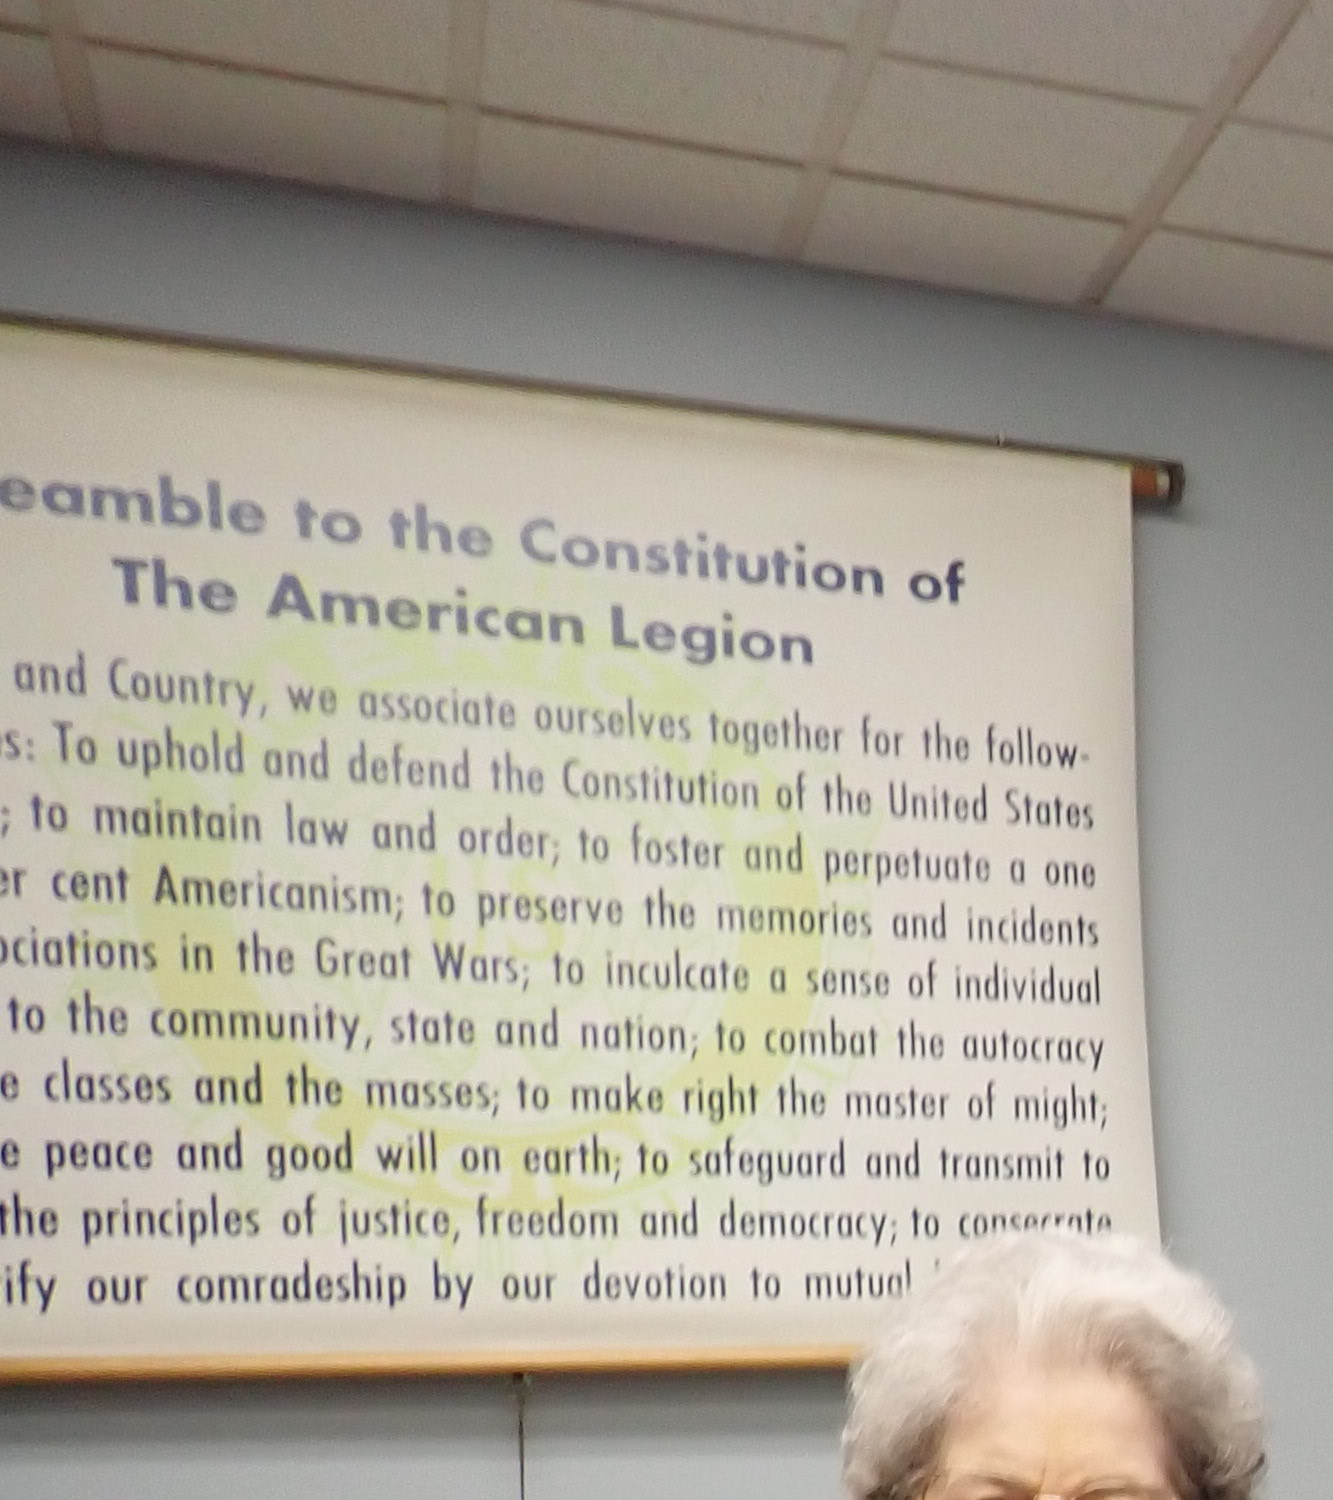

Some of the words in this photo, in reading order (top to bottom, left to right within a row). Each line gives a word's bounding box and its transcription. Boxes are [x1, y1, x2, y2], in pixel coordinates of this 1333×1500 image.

[294, 498, 363, 545] to
[388, 503, 493, 559] the
[519, 517, 885, 599] Constitution
[907, 559, 966, 607] of
[110, 556, 238, 616] The
[265, 572, 585, 646] American
[610, 604, 814, 667] Legion
[13, 649, 87, 697] and
[108, 657, 267, 719] Country,
[287, 685, 338, 715] we
[358, 690, 516, 729] associate
[534, 696, 692, 741] ourselves
[709, 708, 843, 756] together
[860, 713, 904, 758] for
[922, 719, 970, 763] the
[986, 722, 1090, 770] follow-
[0, 730, 35, 762] s:
[51, 720, 98, 766] To
[117, 725, 245, 779] uphold
[263, 737, 330, 781] and
[347, 740, 471, 791] defend
[490, 751, 545, 795] the
[562, 758, 759, 809] Constitution
[775, 770, 806, 813] of
[823, 772, 872, 817] the
[888, 780, 988, 824] United
[1004, 787, 1095, 831] States
[29, 793, 69, 833] to
[94, 797, 262, 843] maintain
[285, 800, 349, 847] law
[371, 808, 437, 853] and
[458, 815, 560, 868] order;
[578, 828, 610, 864] to
[631, 821, 725, 870] foster
[744, 831, 804, 874] and
[824, 847, 991, 887] perpetuate
[1009, 858, 1026, 886] a
[1044, 860, 1096, 890] one
[51, 866, 129, 905] cent
[153, 863, 403, 924] Americanism;
[421, 882, 456, 919] to
[477, 892, 624, 929] preserve
[644, 886, 696, 931] the
[717, 901, 873, 939] memories
[892, 900, 947, 942] and
[967, 903, 1100, 948] incidents
[180, 932, 215, 973] in
[236, 929, 295, 977] the
[314, 936, 412, 980] Great
[432, 941, 530, 993] Wars;
[552, 951, 585, 987] to
[606, 947, 750, 994] inculcate
[769, 966, 787, 995] a
[806, 968, 890, 999] sense
[907, 958, 937, 1000] of
[955, 960, 1101, 1006] individual
[6, 995, 46, 1035] to
[66, 988, 129, 1037] the
[149, 1002, 372, 1053] community,
[390, 1009, 476, 1047] state
[495, 1005, 559, 1049] and
[580, 1014, 698, 1061] nation;
[715, 1020, 746, 1056] to
[764, 1015, 878, 1059] combat
[897, 1017, 945, 1061] the
[962, 1029, 1104, 1073] autocracy
[43, 1056, 173, 1105] classes
[194, 1060, 264, 1107] and
[285, 1061, 344, 1108] the
[365, 1079, 500, 1118] masses;
[516, 1077, 550, 1112] to
[571, 1071, 665, 1114] make
[683, 1072, 759, 1126] right
[777, 1074, 827, 1118] the
[845, 1086, 950, 1121] master
[967, 1079, 996, 1121] of
[1013, 1082, 1107, 1132] might;
[44, 1139, 153, 1181] peace
[176, 1126, 244, 1173] and
[266, 1127, 354, 1182] good
[375, 1128, 438, 1174] will
[460, 1145, 502, 1174] on
[522, 1132, 621, 1185] earth;
[637, 1141, 670, 1178] to
[688, 1133, 846, 1188] safeguard
[865, 1137, 921, 1180] and
[939, 1145, 1065, 1181] transmit
[1082, 1149, 1110, 1182] to
[0, 1191, 59, 1239] the
[81, 1191, 261, 1248] principles
[281, 1192, 317, 1238] of
[339, 1197, 460, 1247] justice,
[476, 1193, 619, 1239] freedom
[639, 1196, 699, 1239] and
[719, 1196, 897, 1249] democracy;
[911, 1206, 940, 1241] to
[86, 1274, 149, 1306] our
[176, 1257, 407, 1310] comradeship
[432, 1257, 474, 1311] by
[501, 1273, 557, 1302] our
[583, 1257, 727, 1301] devotion
[750, 1266, 781, 1301] to
[804, 1257, 912, 1301] mutual
